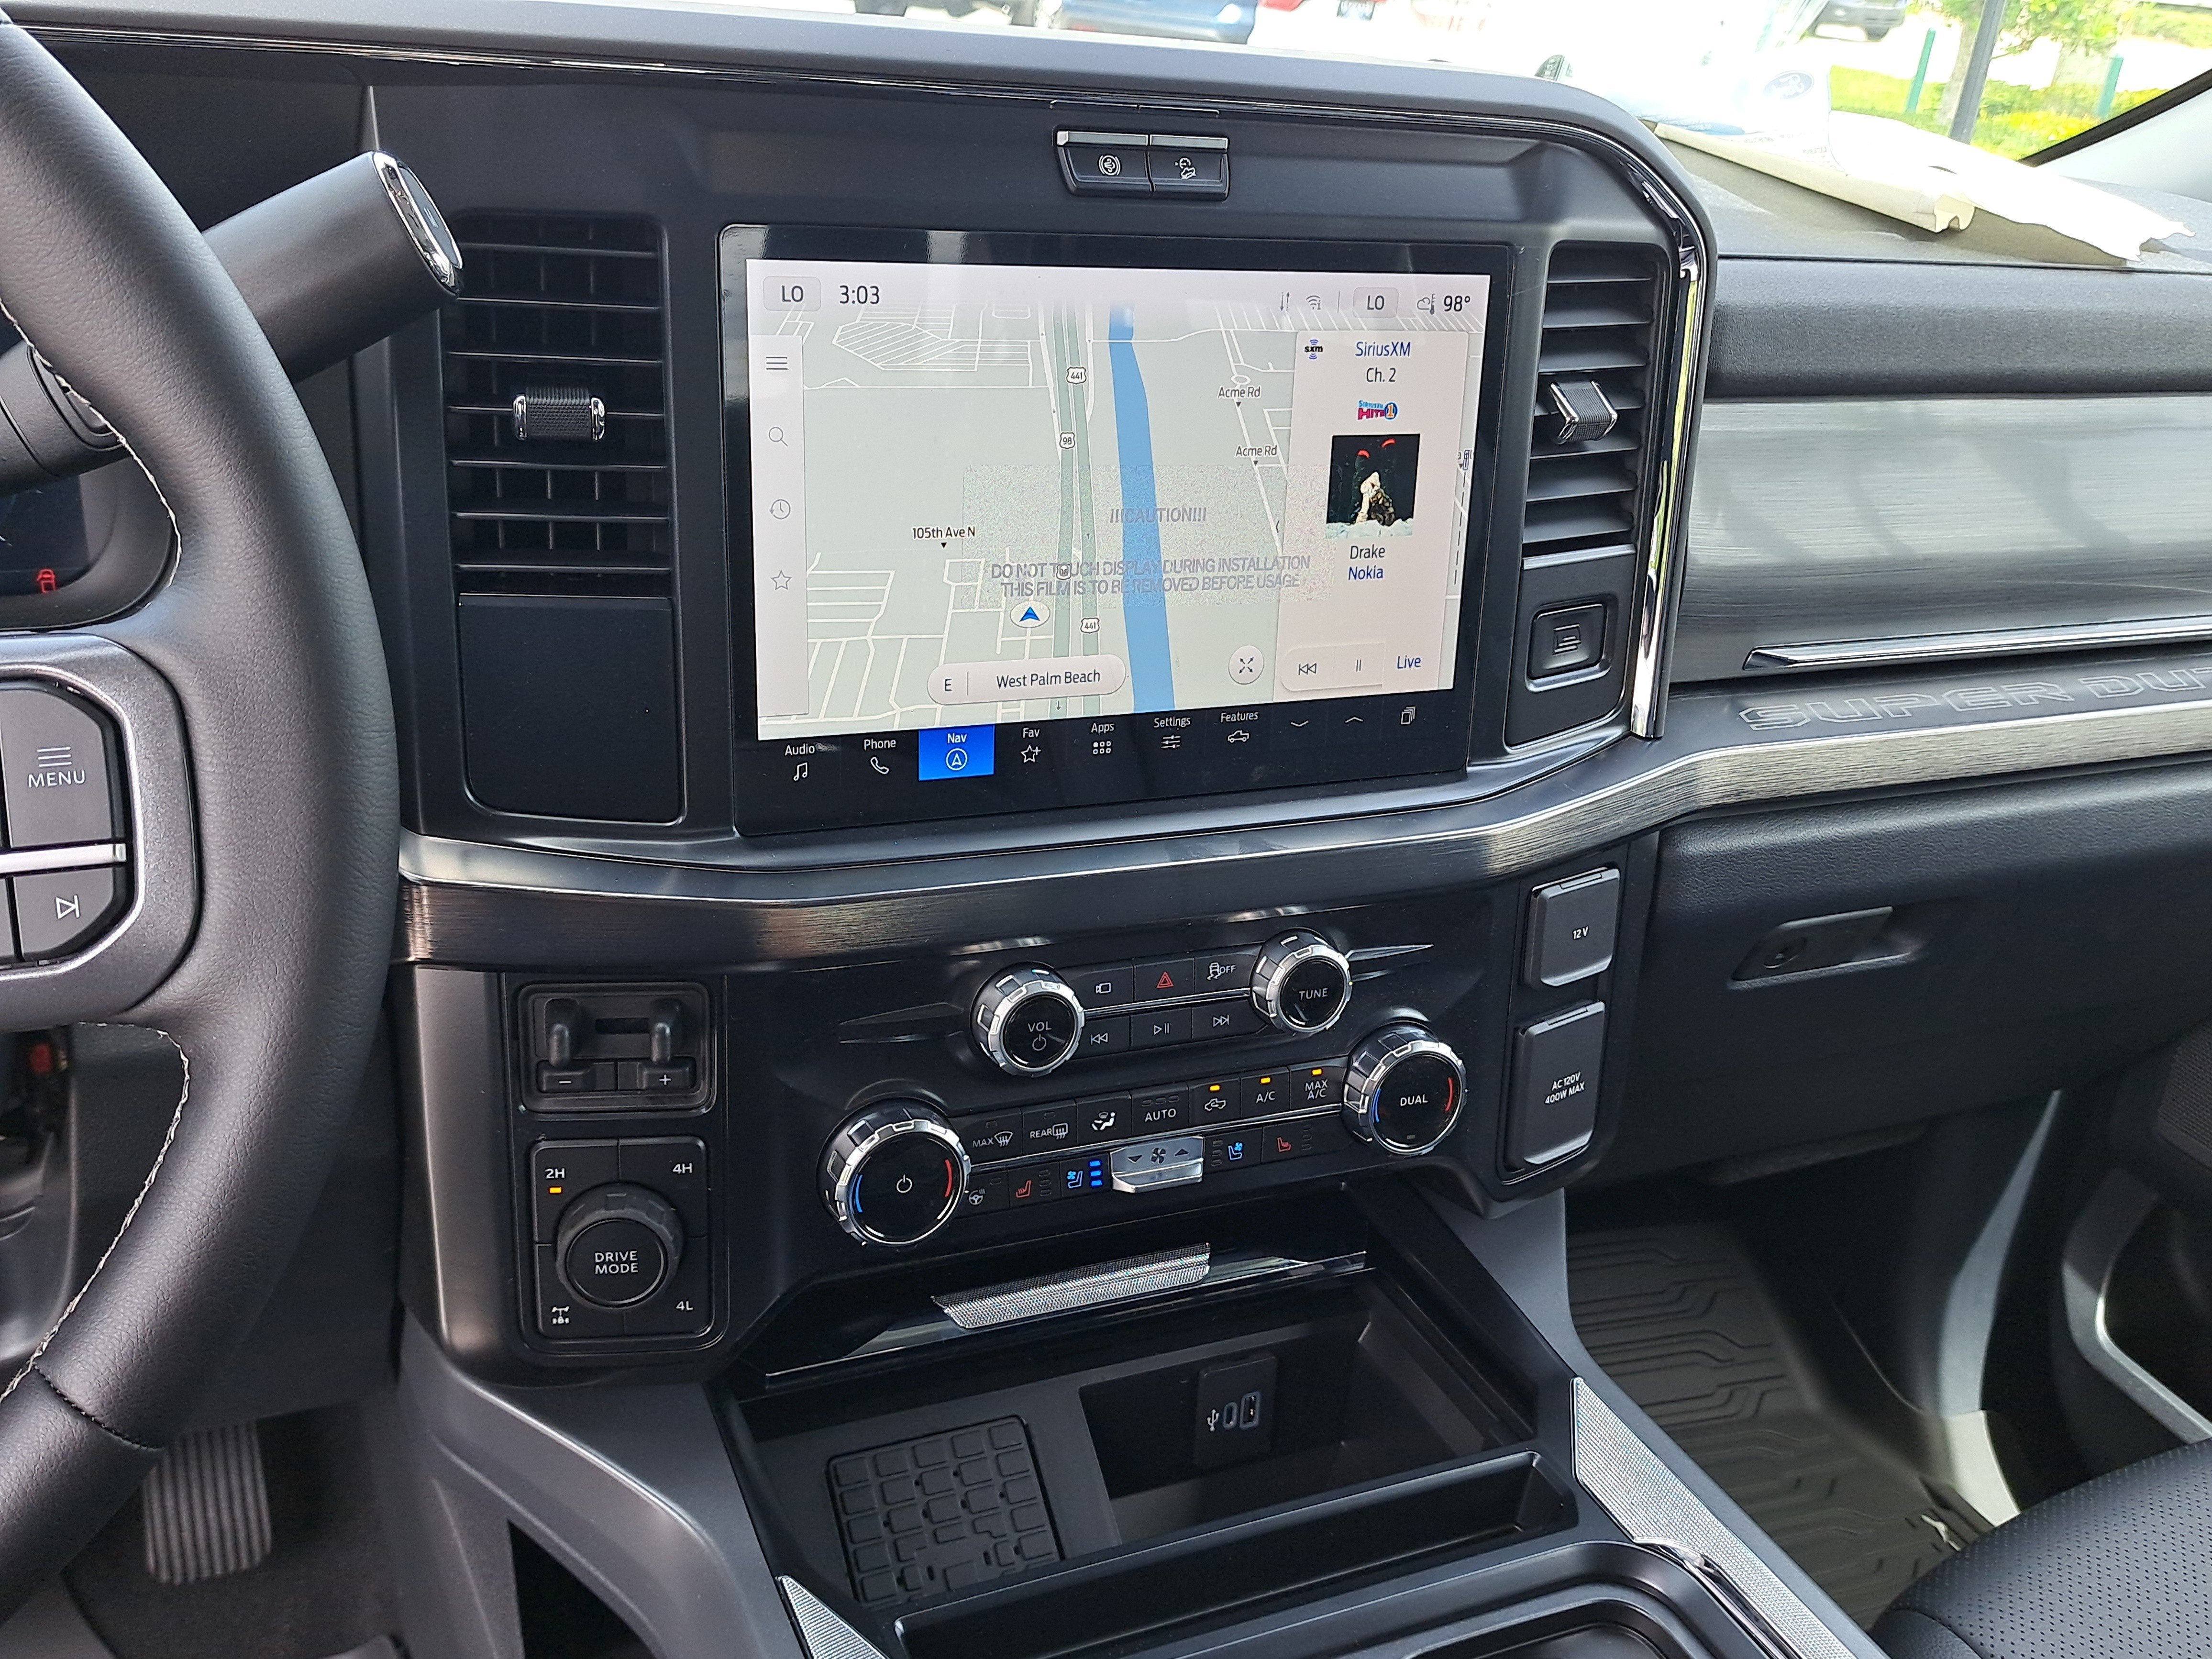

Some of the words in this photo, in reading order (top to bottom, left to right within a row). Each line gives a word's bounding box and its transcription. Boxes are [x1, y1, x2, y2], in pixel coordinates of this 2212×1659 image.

[781, 285, 804, 303] LO
[839, 285, 880, 305] 3:03
[1366, 295, 1384, 310] LO
[1355, 341, 1411, 357] SiriusXM
[1070, 371, 1084, 380] 441
[1366, 367, 1385, 383] Ch.
[1388, 367, 1396, 383] 2
[1217, 387, 1245, 398] Acme
[1246, 386, 1261, 398] Rd
[1062, 436, 1072, 445] 98
[1236, 445, 1261, 457] Acme
[1263, 444, 1277, 456] Rd
[912, 527, 943, 540] 105th
[944, 526, 964, 539] Ave
[967, 526, 976, 538] N
[1349, 544, 1385, 560] Drake
[991, 564, 1013, 579] DO
[1017, 563, 1047, 578] NOT
[1049, 562, 1100, 578] TOUCH
[1103, 559, 1161, 576] DISPLAY
[1163, 558, 1215, 574] DURING
[1218, 555, 1310, 573] INSTALLATION
[1348, 565, 1383, 581] Nokia
[1000, 581, 1034, 597] THIS
[1037, 580, 1071, 597] FILM
[1073, 580, 1086, 595] IS
[1088, 579, 1109, 595] TO
[1111, 579, 1129, 594] BE
[1132, 576, 1200, 593] REMOVED
[1202, 575, 1255, 591] BEFORE
[1256, 573, 1300, 589] USAGE
[1084, 621, 1096, 630] 441
[1396, 654, 1422, 670] Live
[944, 679, 952, 691] E
[996, 674, 1028, 689] West
[1030, 672, 1062, 686] Palm
[1064, 669, 1101, 684] Beach
[1738, 682, 2075, 731] SUPER
[2078, 667, 2212, 699] DU
[1153, 716, 1192, 730] Settings
[1220, 710, 1259, 724] Features
[1022, 727, 1040, 739] Fav
[1090, 722, 1115, 736] Apps
[863, 737, 896, 751] Phone
[947, 732, 967, 745] Nav
[785, 743, 815, 756] Audio
[28, 770, 86, 788] MENU
[1219, 963, 1236, 975] OFF
[1298, 987, 1329, 1001] TUNE
[1027, 1021, 1052, 1033] VOL
[1304, 1079, 1329, 1092] MAX
[1545, 1089, 1568, 1104] 400W
[1568, 1081, 1585, 1097] MAX
[1256, 1090, 1276, 1104] A/C
[1306, 1087, 1327, 1101] A/C
[1399, 1094, 1429, 1107] DUAL
[1144, 1107, 1177, 1122] AUTO
[1029, 1127, 1052, 1139] REAR
[972, 1137, 994, 1148] MAX
[545, 1168, 565, 1180] 2H
[672, 1163, 693, 1175] 4H
[594, 1250, 638, 1263] DRIVE
[594, 1262, 639, 1275] MODE
[675, 1301, 694, 1312] 4L
